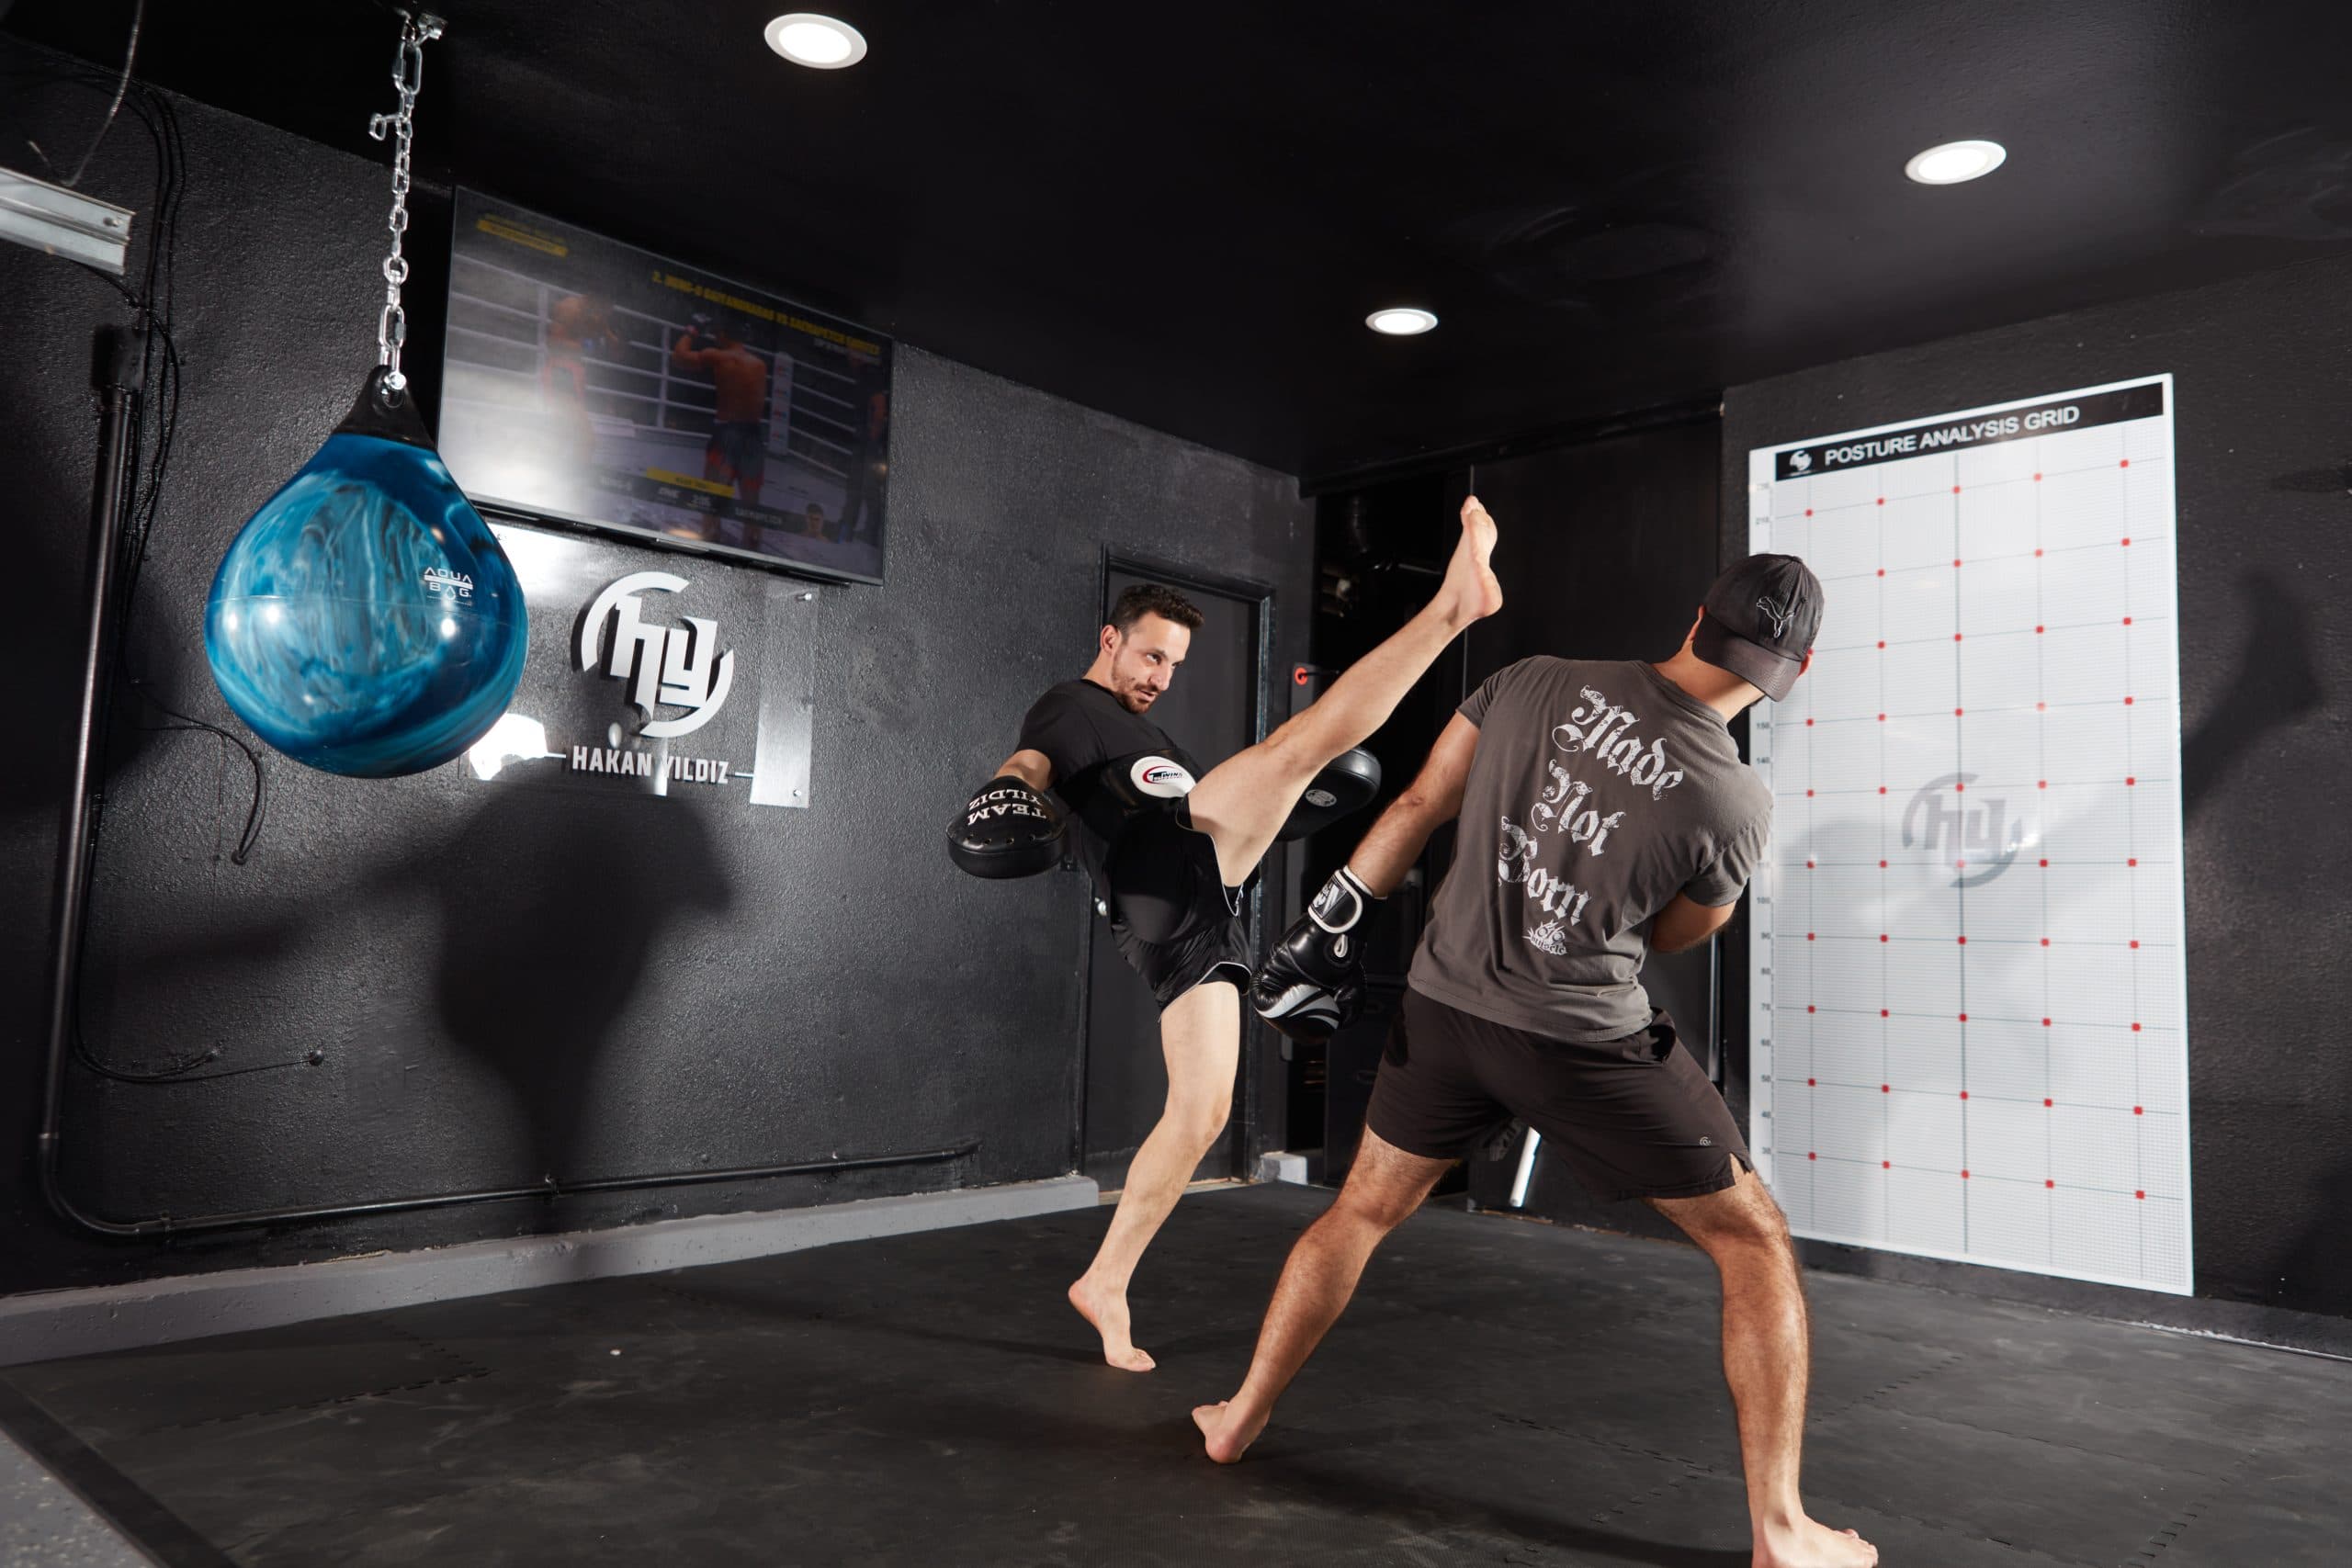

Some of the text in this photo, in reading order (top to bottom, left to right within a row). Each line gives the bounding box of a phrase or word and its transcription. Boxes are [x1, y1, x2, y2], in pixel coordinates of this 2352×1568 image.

[1825, 406, 2080, 466] POSTURE ANALYSIS GRID
[424, 567, 473, 584] AQUA
[571, 745, 729, 784] HAKAN YILDIZ
[1552, 684, 1685, 801] Made
[967, 803, 1047, 826] TEAM
[968, 788, 1044, 811] YILDIZ
[1531, 758, 1626, 857] Not
[1498, 815, 1592, 927] Born
